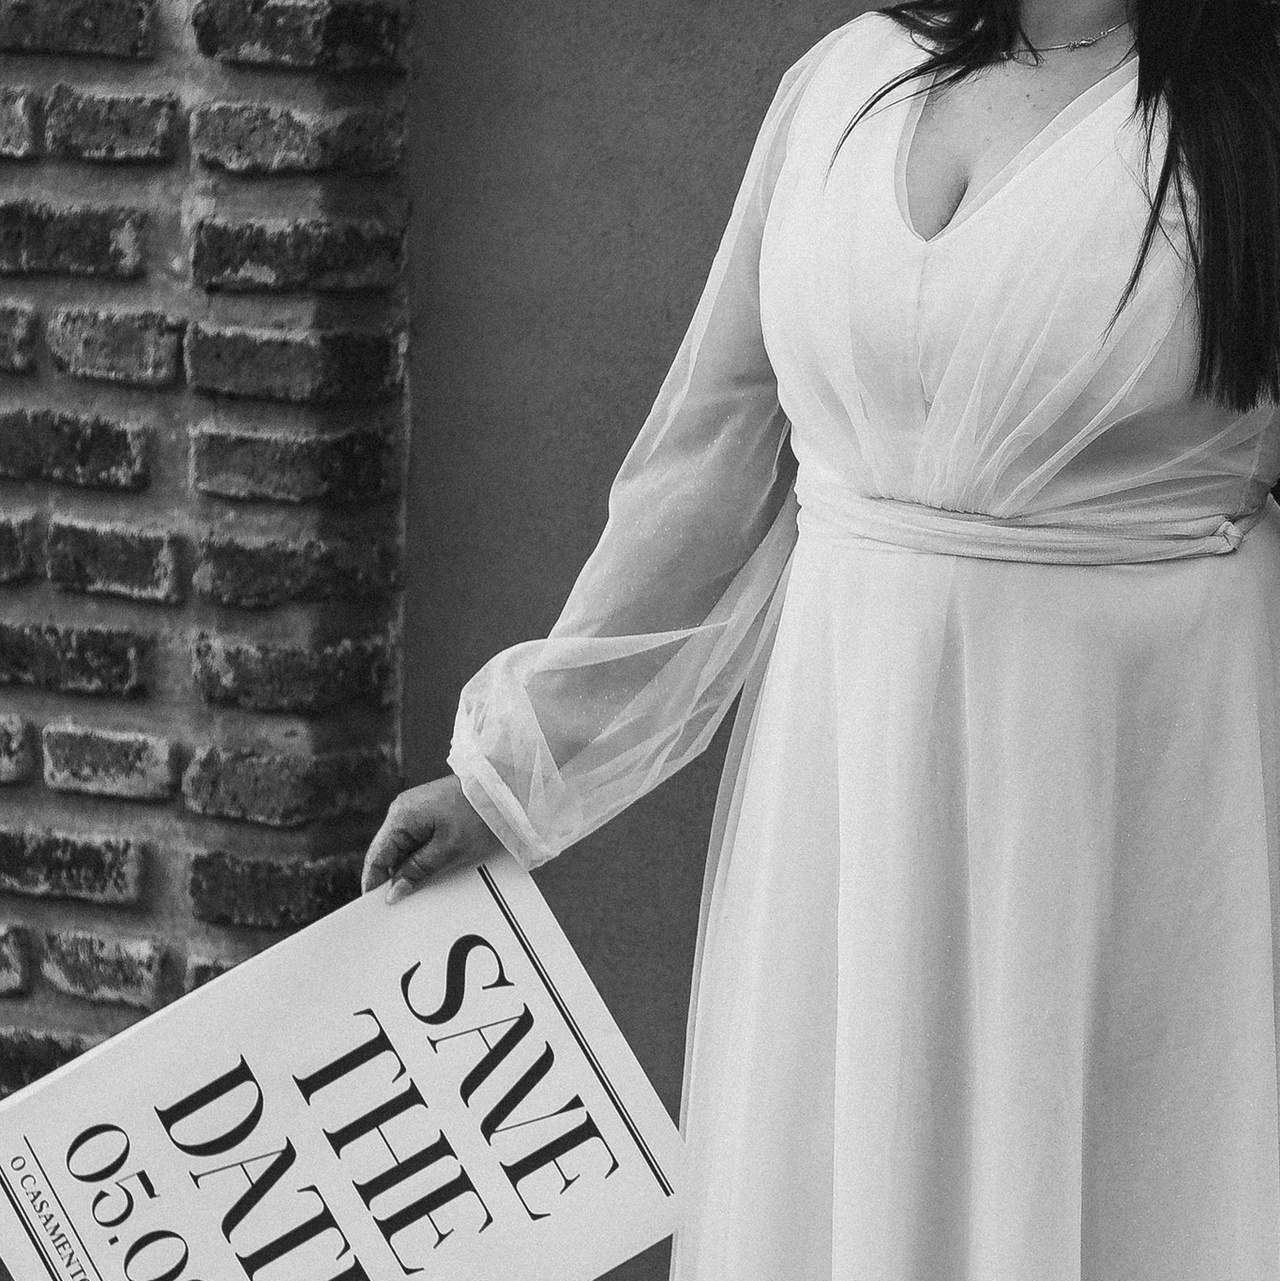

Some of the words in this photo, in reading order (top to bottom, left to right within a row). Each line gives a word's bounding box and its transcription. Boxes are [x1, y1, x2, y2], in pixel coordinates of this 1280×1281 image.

[10, 1156, 26, 1171] O
[292, 1007, 494, 1276] THE
[400, 934, 620, 1221] SAVE
